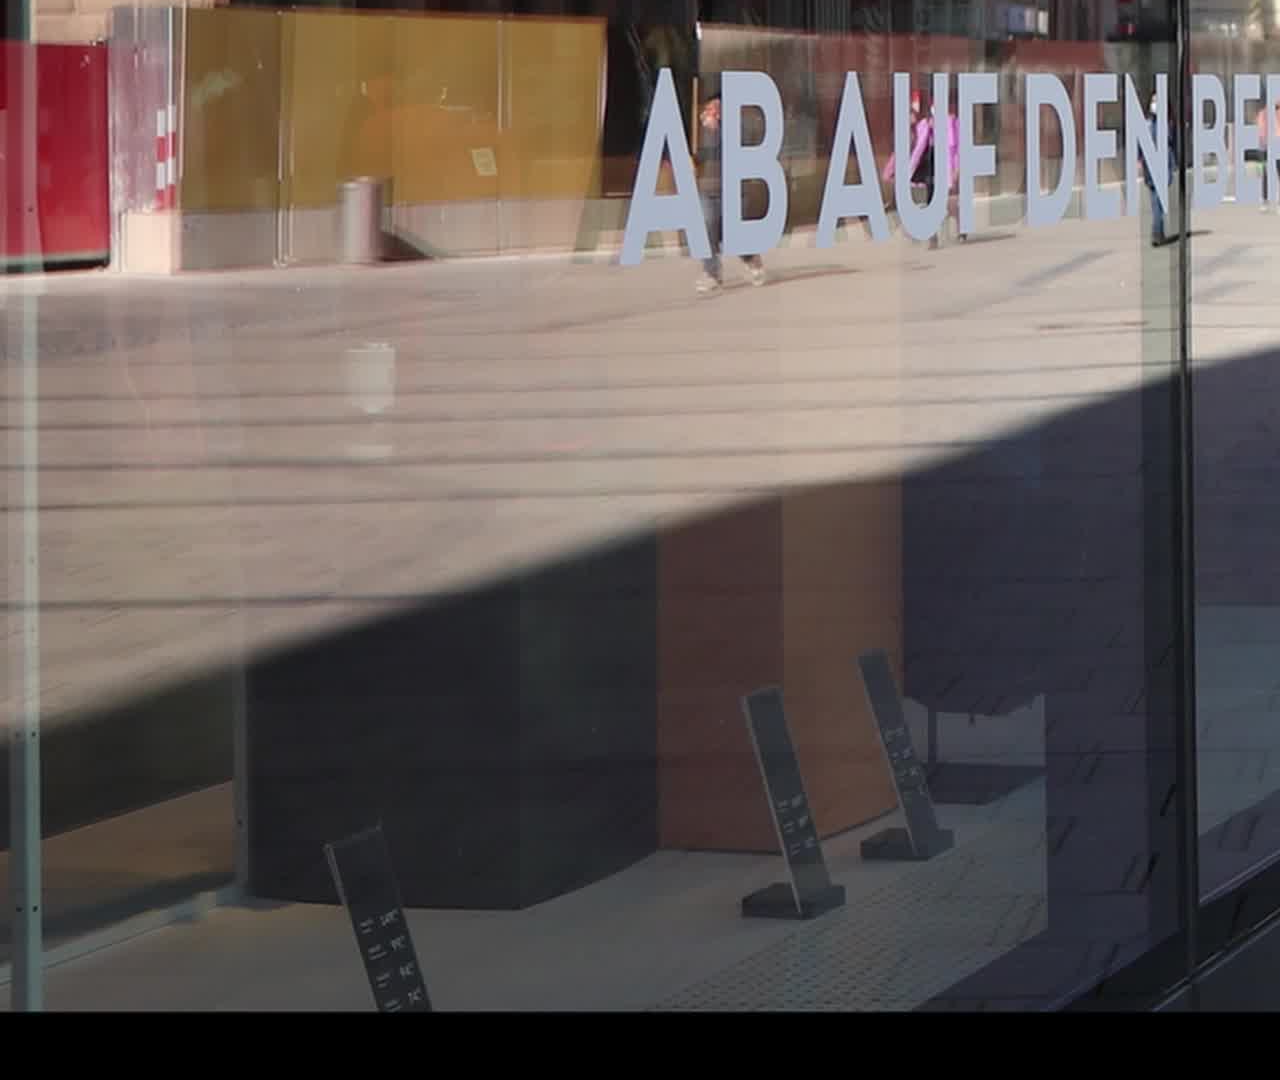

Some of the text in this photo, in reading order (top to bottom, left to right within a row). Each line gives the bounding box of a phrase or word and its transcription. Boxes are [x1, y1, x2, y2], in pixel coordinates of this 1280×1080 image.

[619, 66, 788, 266] AB
[815, 70, 998, 249] AUF
[1025, 71, 1171, 226] DEN
